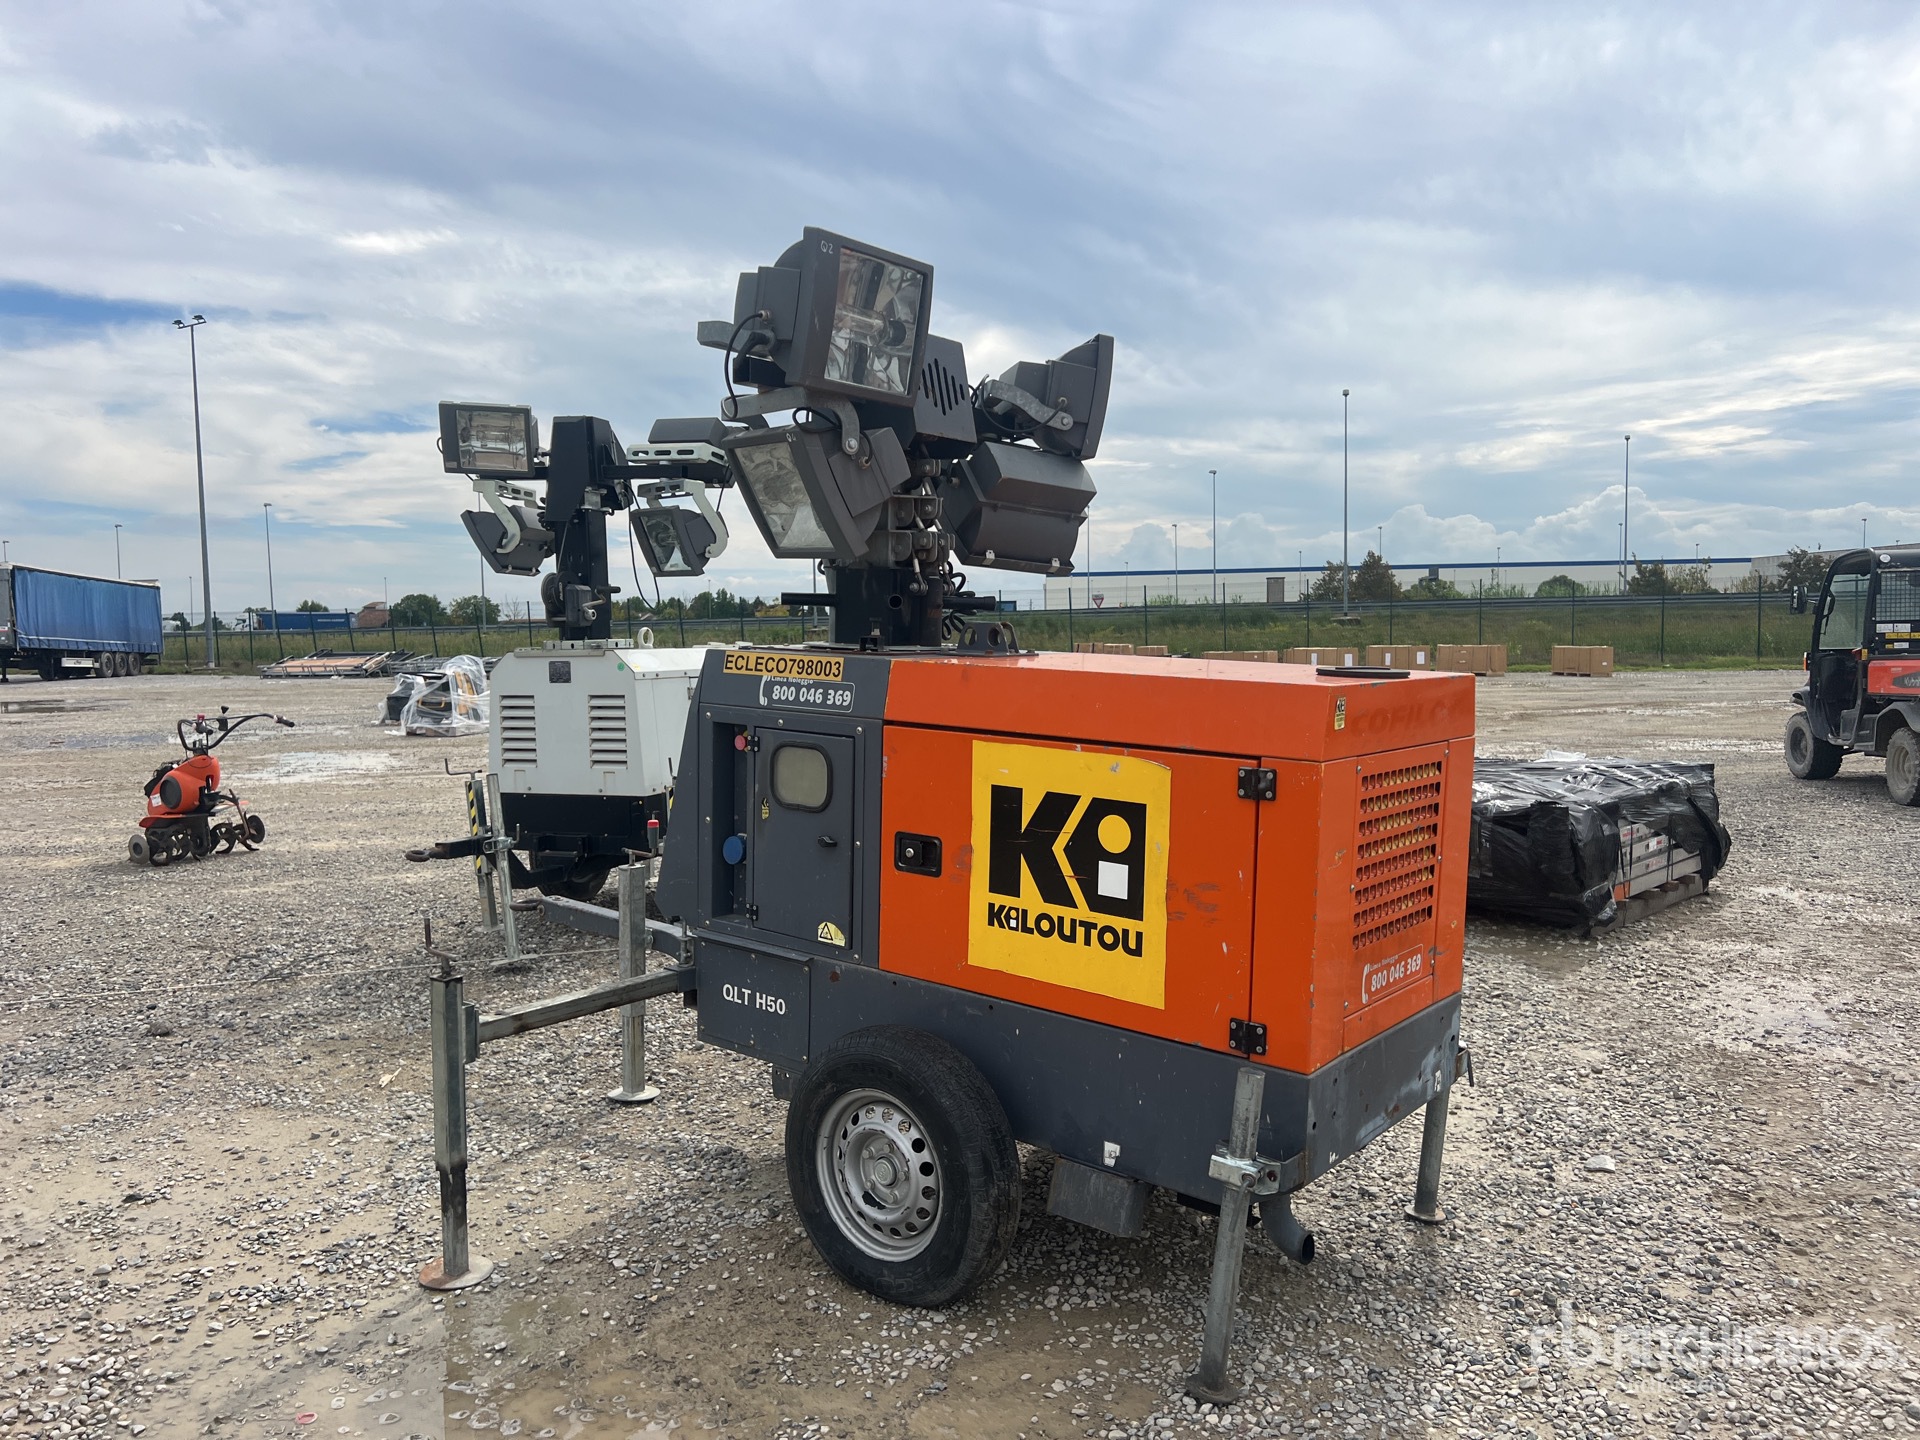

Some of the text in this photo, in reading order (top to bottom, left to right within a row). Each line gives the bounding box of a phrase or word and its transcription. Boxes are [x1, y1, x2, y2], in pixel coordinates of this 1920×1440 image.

[724, 654, 842, 678] ECLECO798003
[772, 685, 851, 706] 800 046 369
[1371, 953, 1421, 992] 800 046 369
[722, 983, 786, 1015] QLT H50
